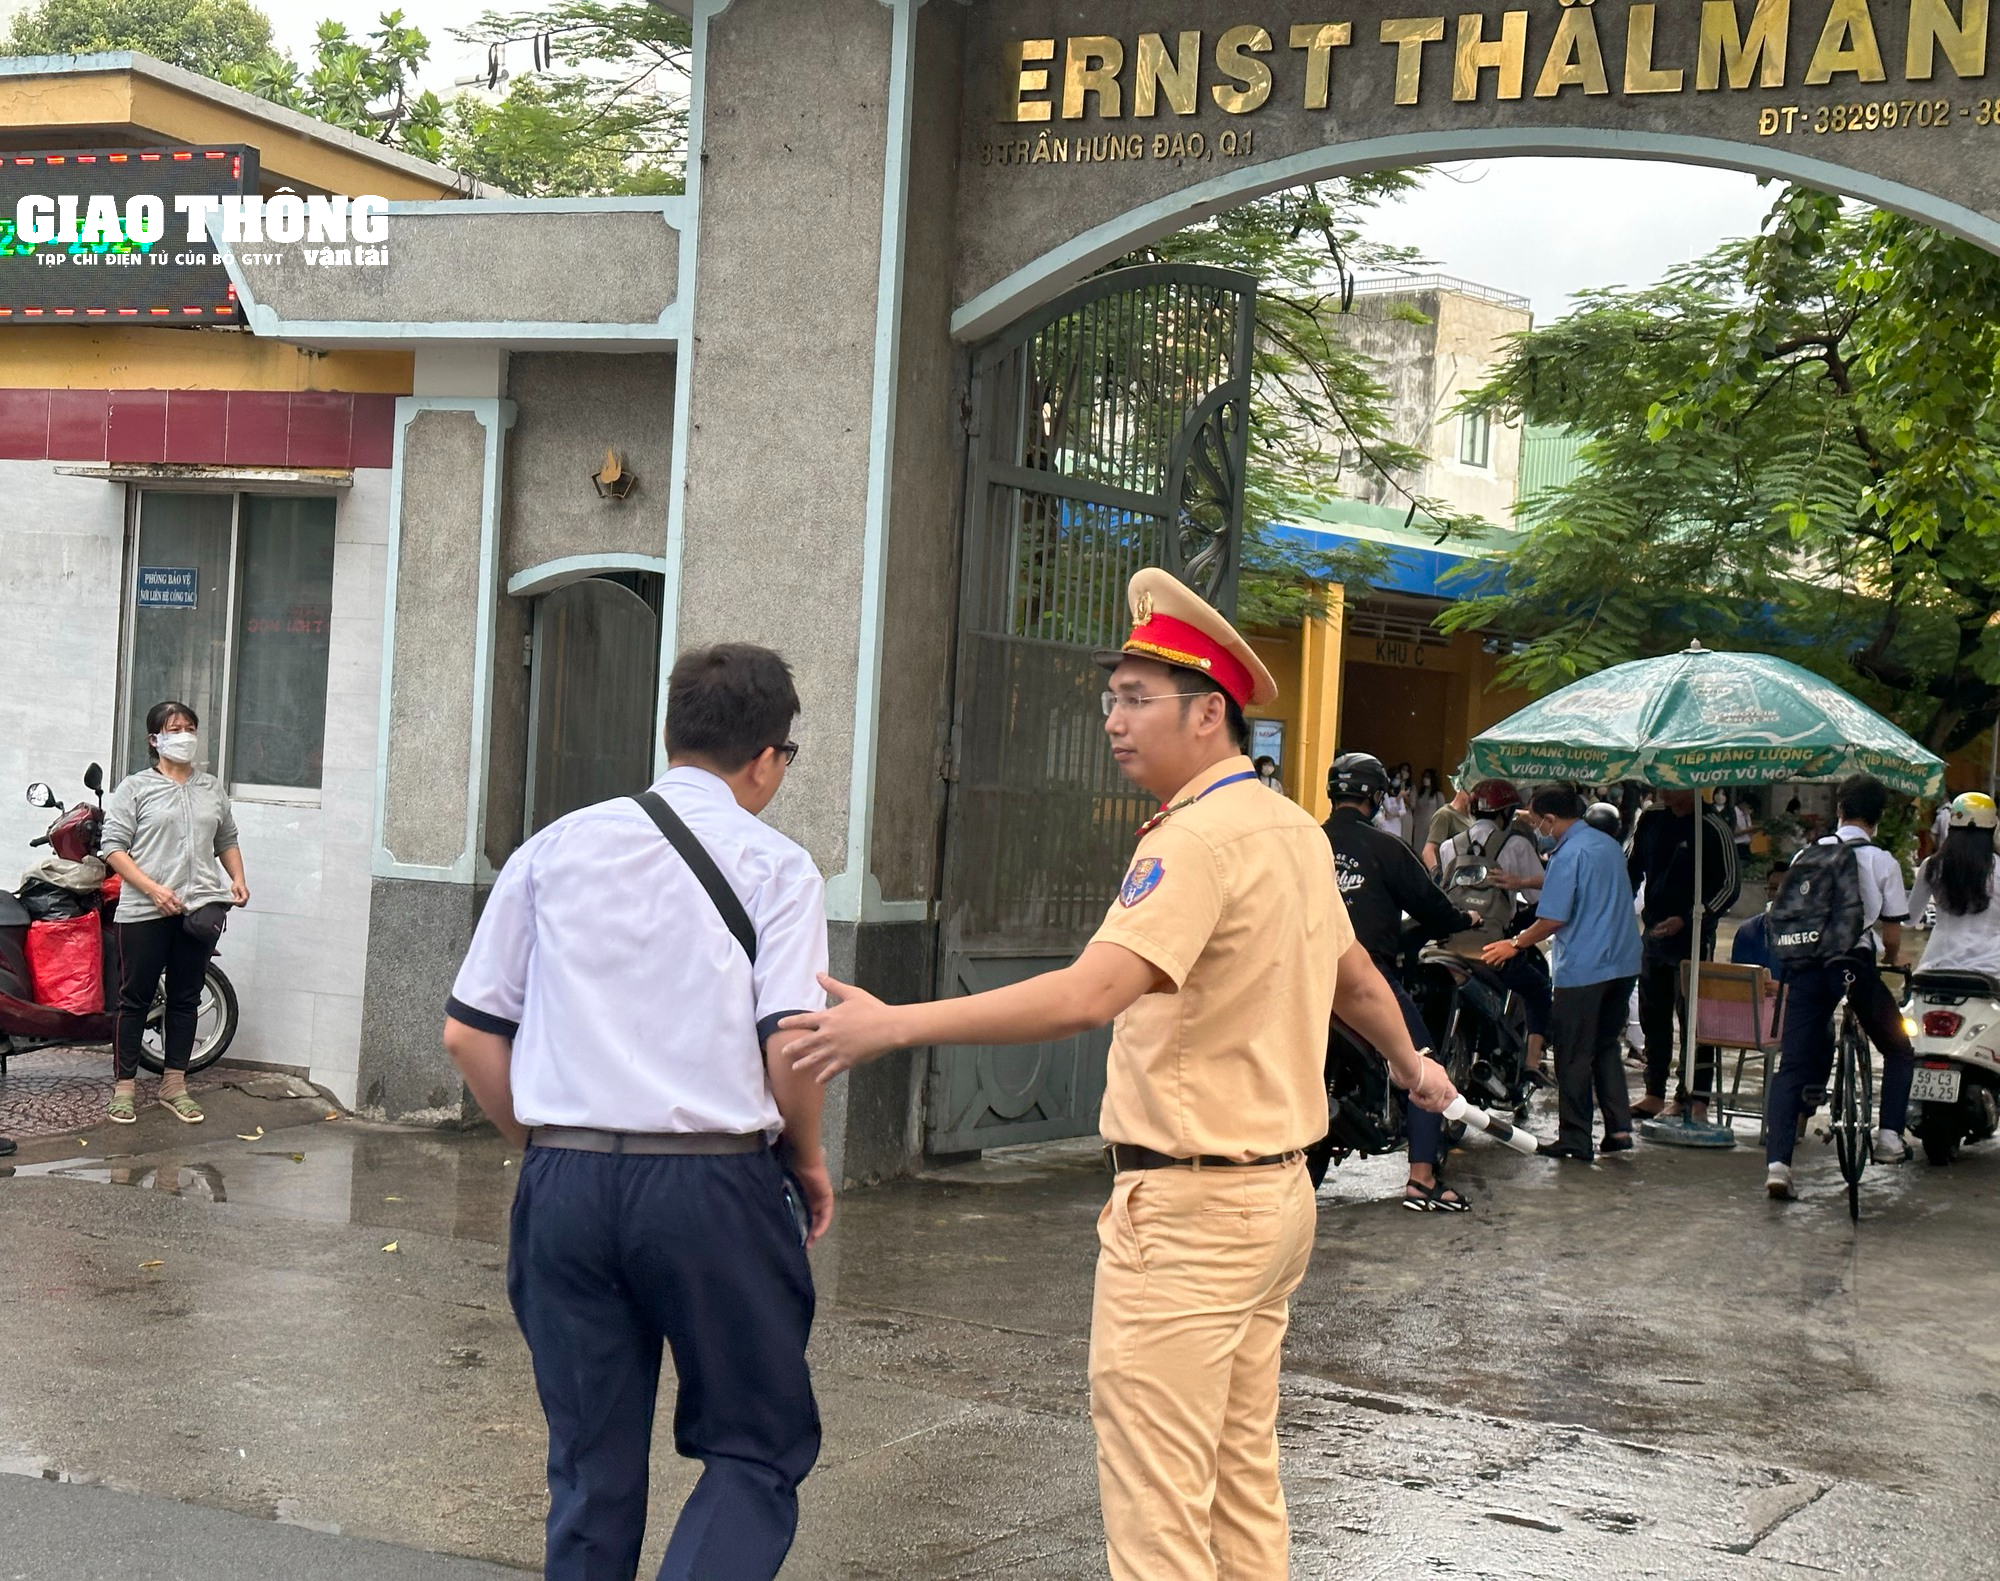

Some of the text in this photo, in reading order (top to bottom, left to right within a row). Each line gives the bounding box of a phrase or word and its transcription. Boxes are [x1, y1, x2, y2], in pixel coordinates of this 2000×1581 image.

[999, 20, 1352, 122] ERNST
[1814, 100, 1949, 134] 38299702
[998, 128, 1068, 165] TRẦN
[1076, 132, 1144, 162] HƯNG
[1151, 130, 1212, 167] ĐẠO,
[1219, 129, 1253, 158] Q.1
[1376, 641, 1407, 664] KHU
[1567, 748, 1608, 763] LƯỢNG
[1673, 746, 1813, 765] TIẾP NĂNG LƯỢNG
[1511, 763, 1598, 779] VƯỢT VŨ MÔN
[1690, 765, 1798, 784] VƯỢT VŨ MÔN
[1917, 1071, 1952, 1086] 59-C3
